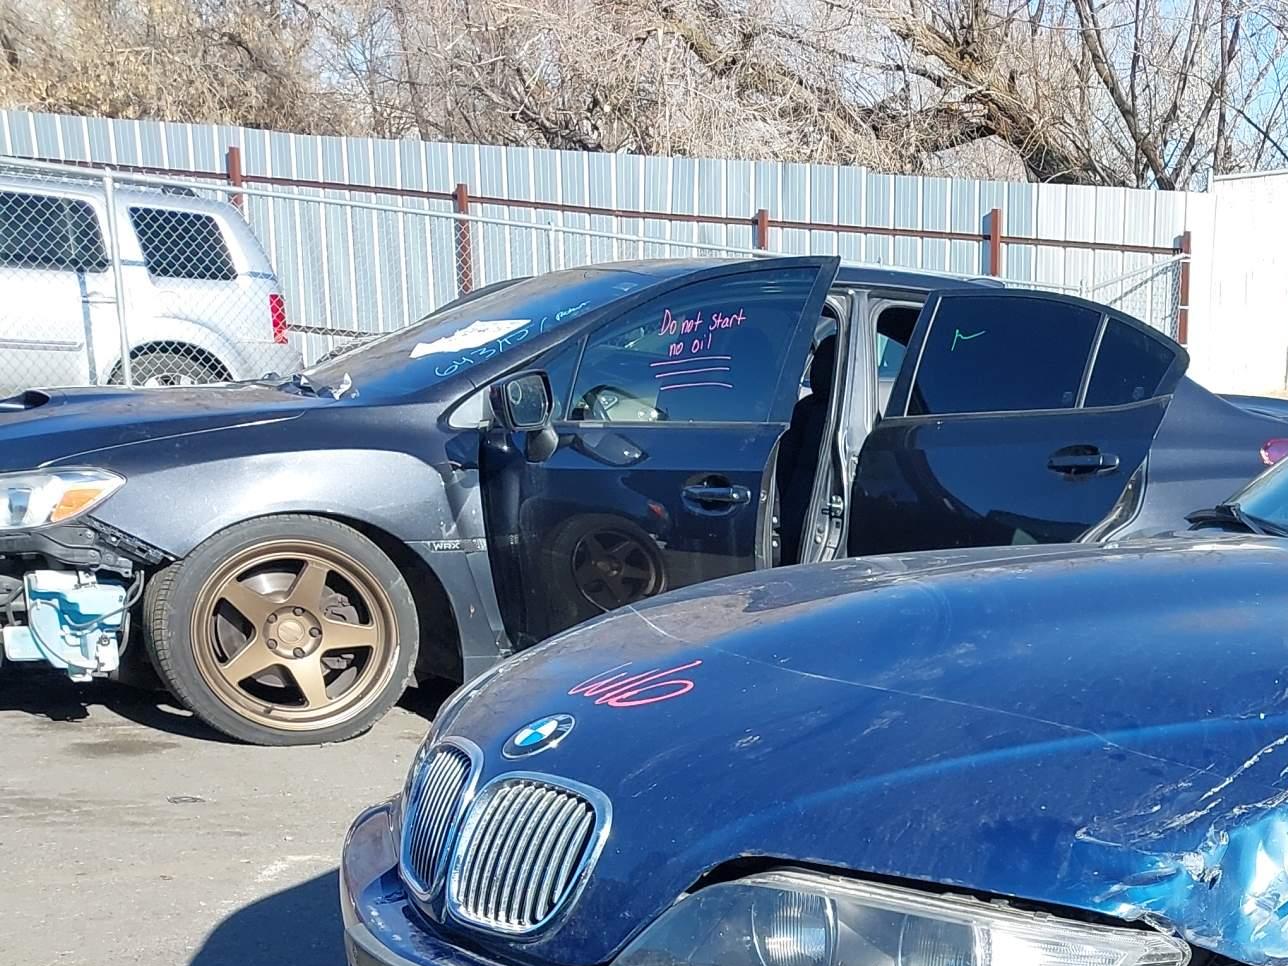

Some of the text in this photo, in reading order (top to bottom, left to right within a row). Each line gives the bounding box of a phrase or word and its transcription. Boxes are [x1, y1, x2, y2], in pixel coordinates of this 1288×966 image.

[658, 308, 677, 335] Do
[681, 311, 704, 334] not
[669, 342, 684, 356] no
[433, 542, 460, 551] WRX
